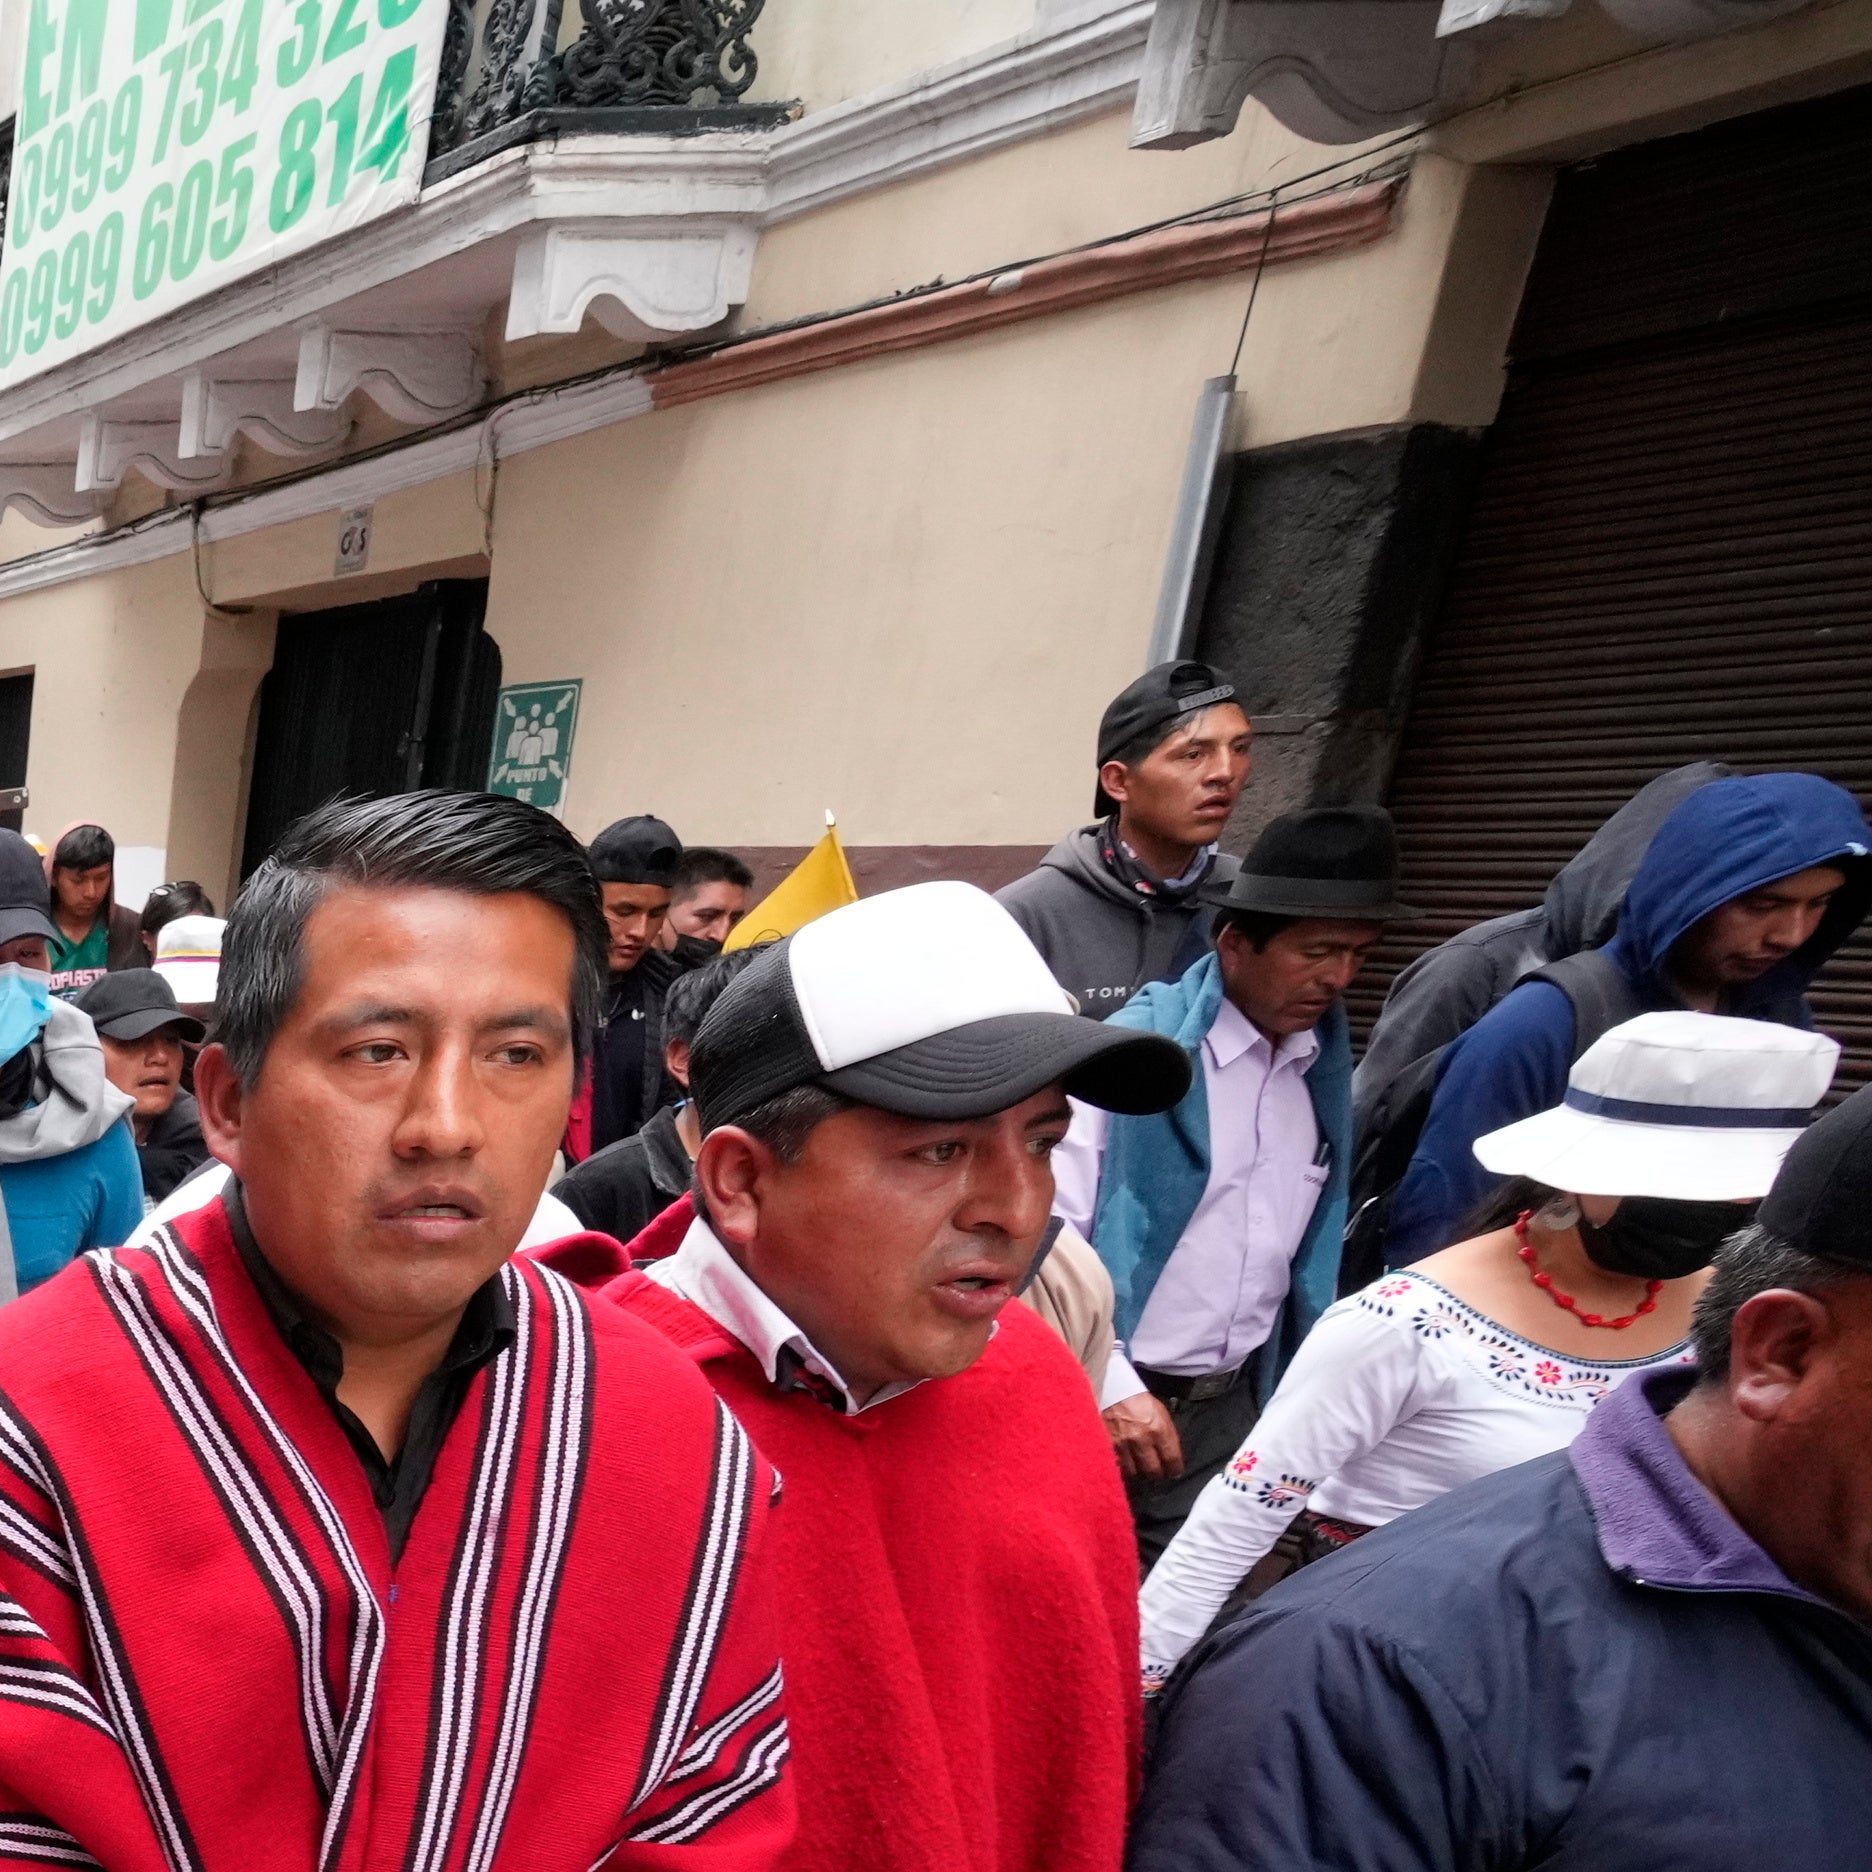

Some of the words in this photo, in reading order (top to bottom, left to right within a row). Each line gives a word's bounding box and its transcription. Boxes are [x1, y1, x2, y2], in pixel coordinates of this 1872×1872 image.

[12, 74, 143, 250] 0999
[152, 0, 261, 168] 734
[276, 0, 422, 89] 32
[132, 131, 257, 302] 605
[269, 44, 418, 234] 814
[506, 766, 548, 784] PUNTO
[1085, 986, 1135, 999] TOM
